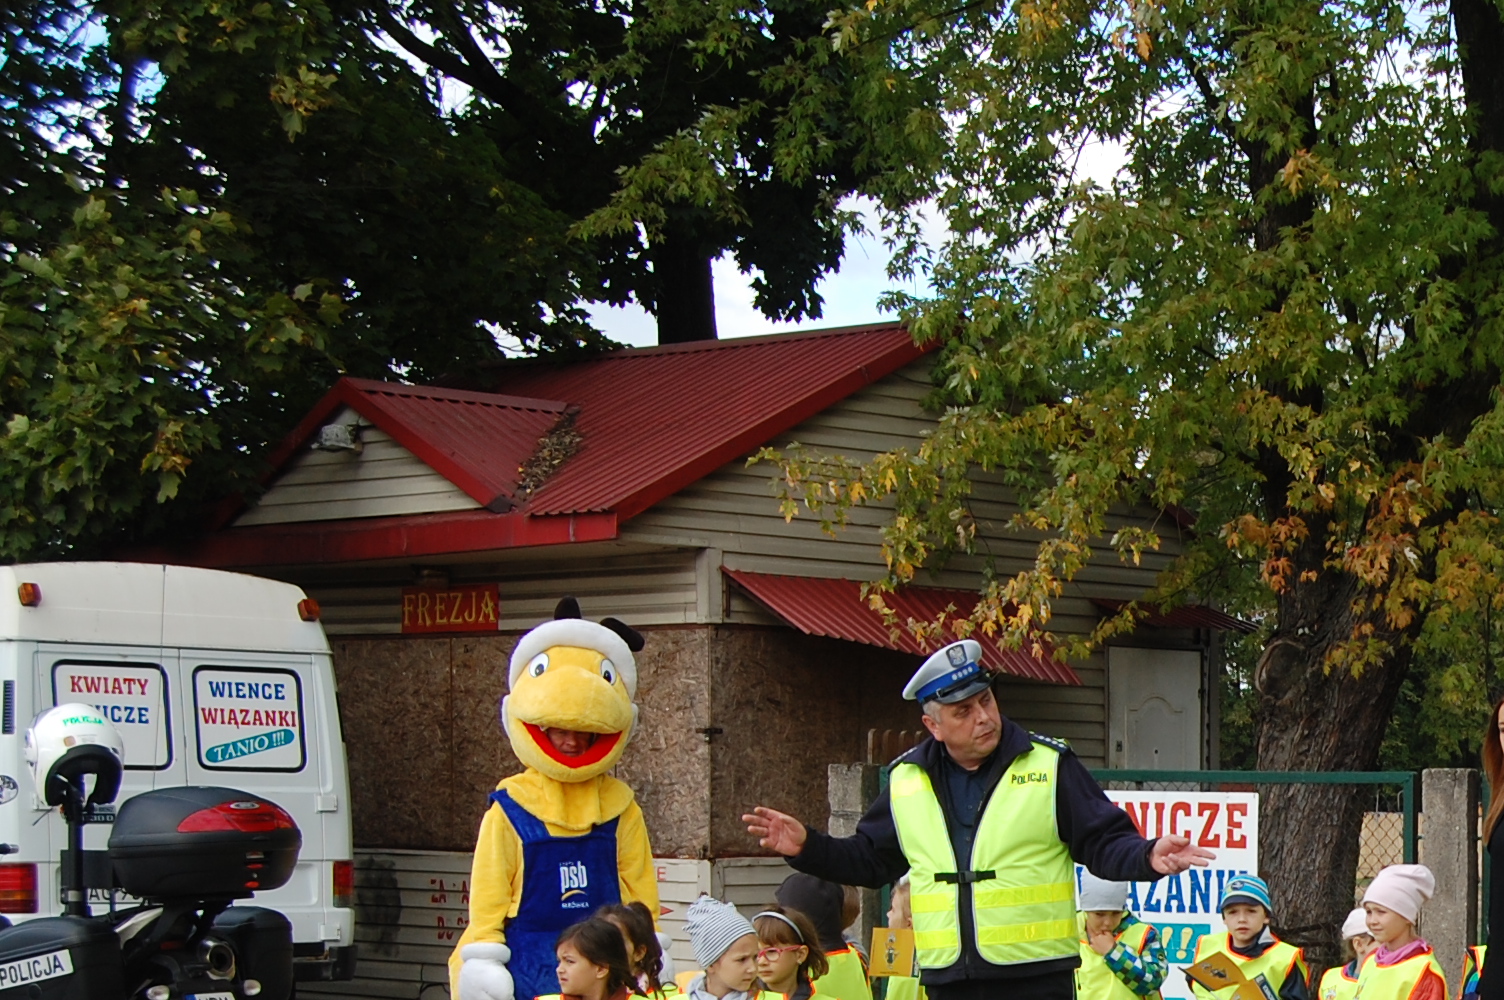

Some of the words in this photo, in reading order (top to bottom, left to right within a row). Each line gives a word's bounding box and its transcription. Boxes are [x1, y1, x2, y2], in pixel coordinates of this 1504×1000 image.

[403, 590, 497, 628] FREZJA
[70, 674, 149, 696] KWIATY
[208, 680, 286, 700] WIENCE
[200, 706, 297, 729] WIĄZANKI
[212, 735, 269, 762] TANIO
[1011, 772, 1048, 785] POLICJA
[1112, 801, 1249, 848] NICZE
[559, 860, 589, 894] psb
[0, 954, 66, 987] POLICJA
